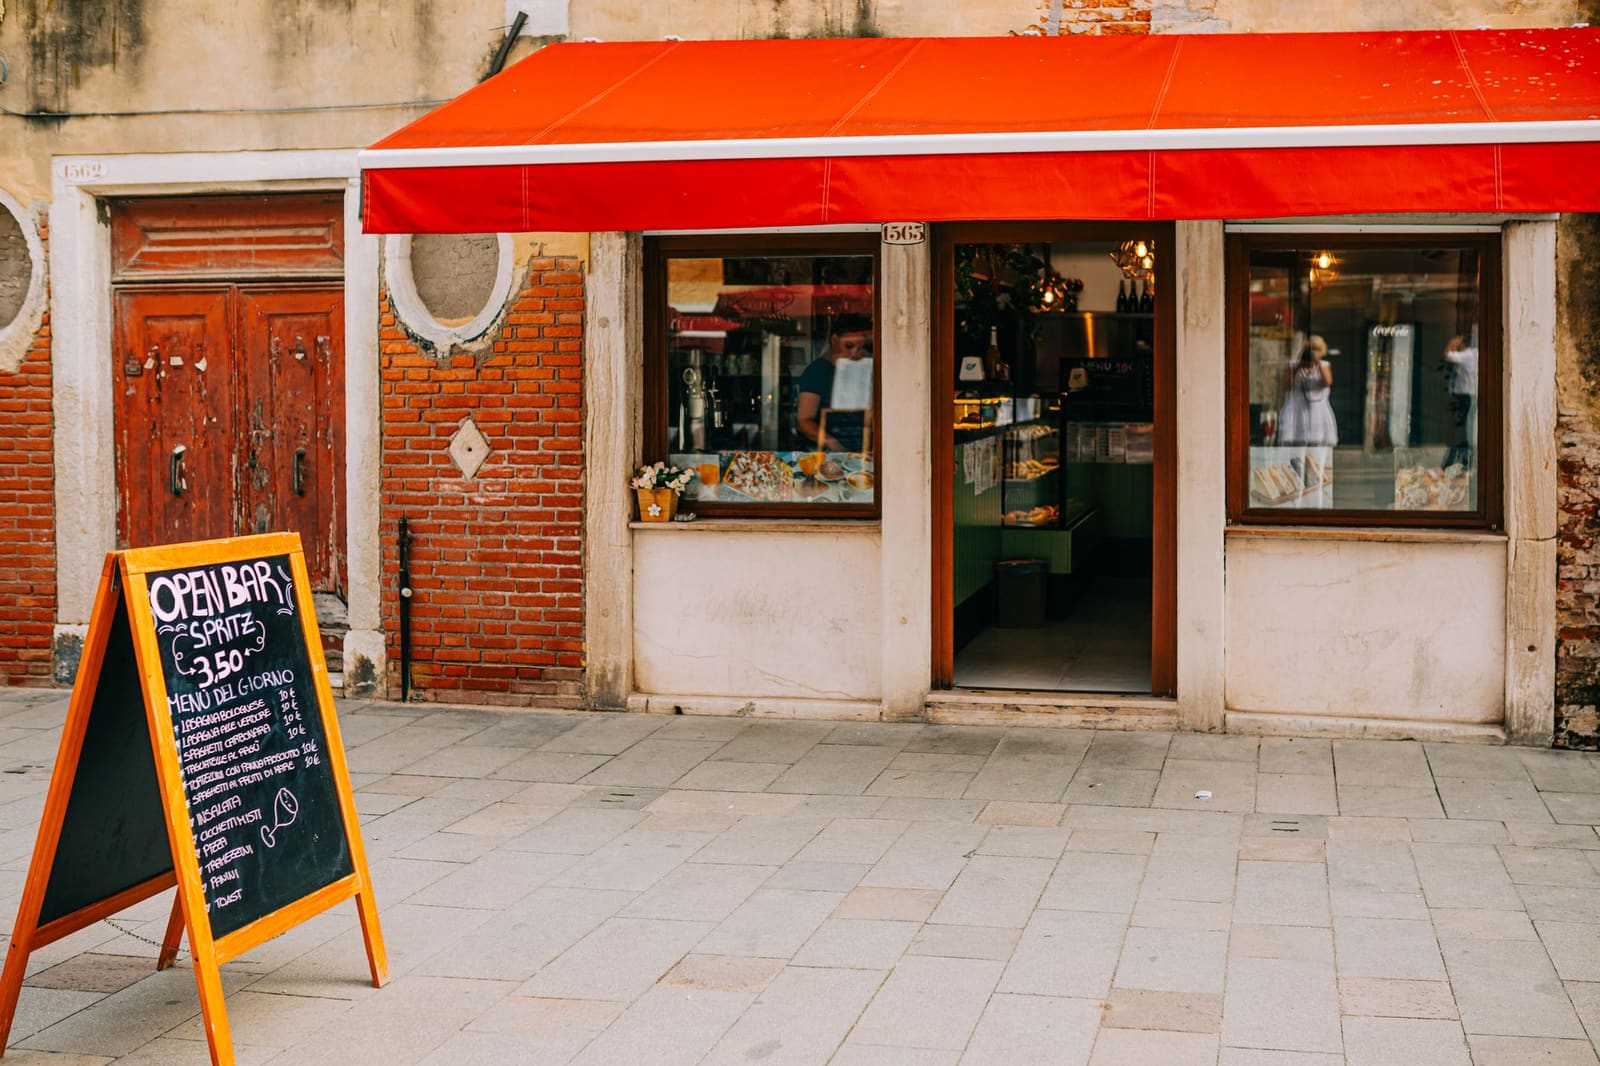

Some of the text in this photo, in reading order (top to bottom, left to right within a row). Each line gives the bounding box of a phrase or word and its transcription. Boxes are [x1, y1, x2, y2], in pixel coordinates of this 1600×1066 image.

[150, 561, 284, 622] OPEN BAR
[190, 611, 256, 649] SPRITZ
[192, 649, 243, 689] 3,50
[213, 683, 237, 706] DEL
[238, 669, 294, 696] GIORNO
[181, 712, 220, 733] LASAGNA
[220, 698, 265, 721] BOLOGNESE
[182, 727, 221, 748] LASAGNA
[220, 721, 238, 735] ALLE
[183, 740, 223, 761] SPAGHETTI
[224, 723, 271, 748] CARBONARA
[225, 765, 241, 777] CON
[228, 752, 239, 761] AL
[191, 780, 229, 805] SPAGHETTI
[263, 768, 273, 778] DI
[273, 760, 295, 774] MARE
[196, 795, 242, 826] INSALATA
[200, 817, 238, 842] CICCHETTI
[202, 836, 228, 857] PIZZA
[204, 844, 254, 873] TRAMEZZINI
[210, 868, 240, 889] PANINI
[214, 888, 243, 909] TOAST
